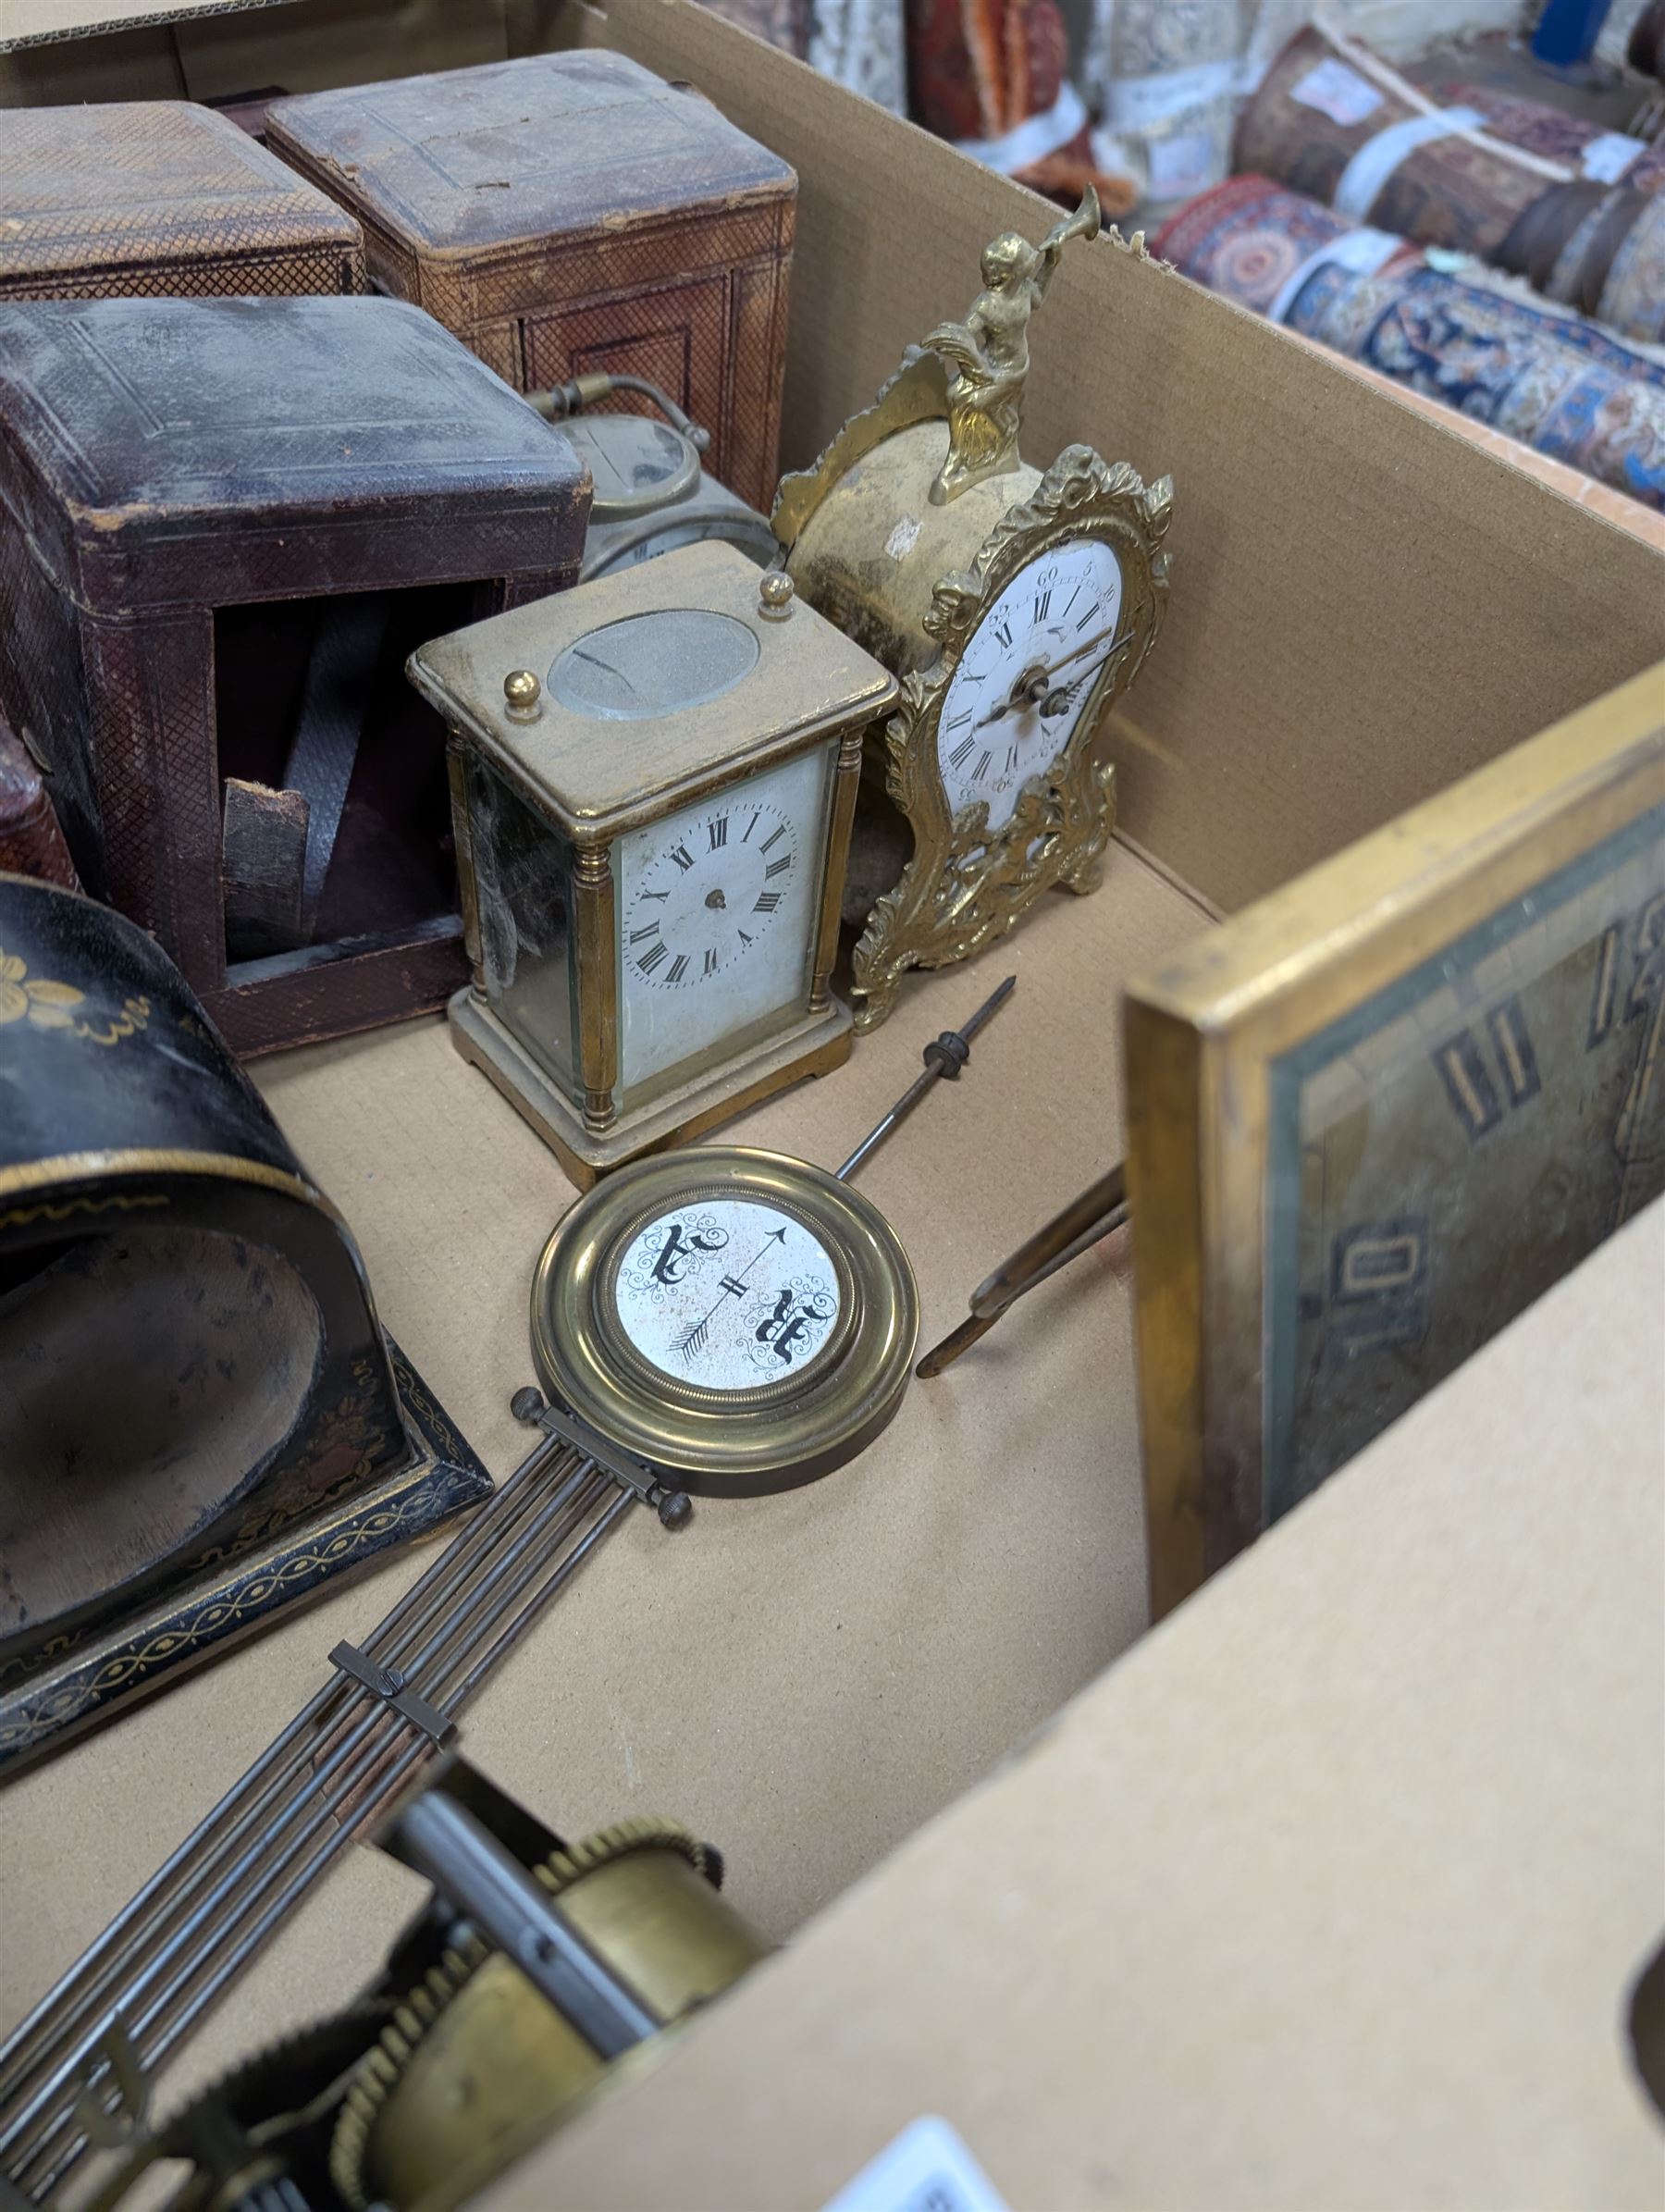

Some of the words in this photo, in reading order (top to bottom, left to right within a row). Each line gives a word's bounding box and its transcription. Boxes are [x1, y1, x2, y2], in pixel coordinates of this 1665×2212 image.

[1037, 565, 1058, 587] 60
[1028, 589, 1052, 629] XII
[1076, 600, 1101, 634] II
[962, 670, 987, 689] X
[947, 732, 978, 772] VIII
[969, 749, 995, 782] VII
[706, 816, 729, 854] XII
[740, 811, 761, 844] I
[758, 823, 786, 856] II
[668, 844, 697, 876] XI
[764, 853, 791, 882] III
[639, 888, 672, 904] X
[750, 890, 783, 914] IIII
[629, 919, 660, 946] IX
[737, 928, 753, 948] V
[635, 939, 670, 976] VIII
[663, 954, 692, 983] VII
[702, 946, 719, 976] VI
